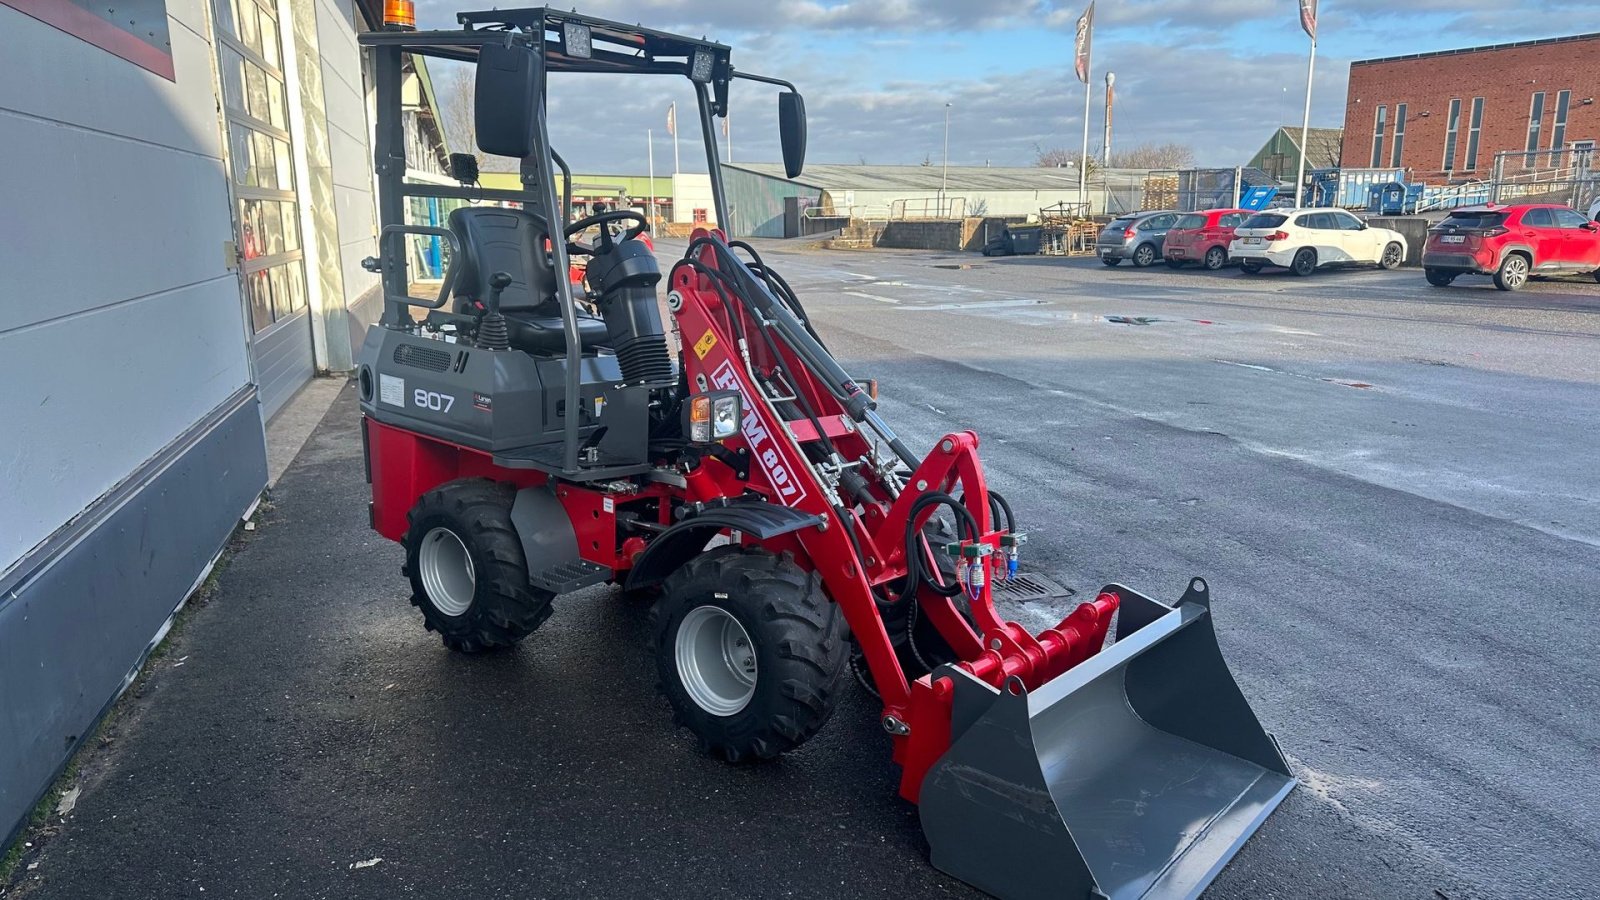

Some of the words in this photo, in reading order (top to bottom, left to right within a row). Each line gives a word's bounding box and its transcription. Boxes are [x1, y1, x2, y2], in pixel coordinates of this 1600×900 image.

[414, 388, 454, 413] 807
[716, 368, 768, 448] HM
[762, 448, 797, 496] 807
